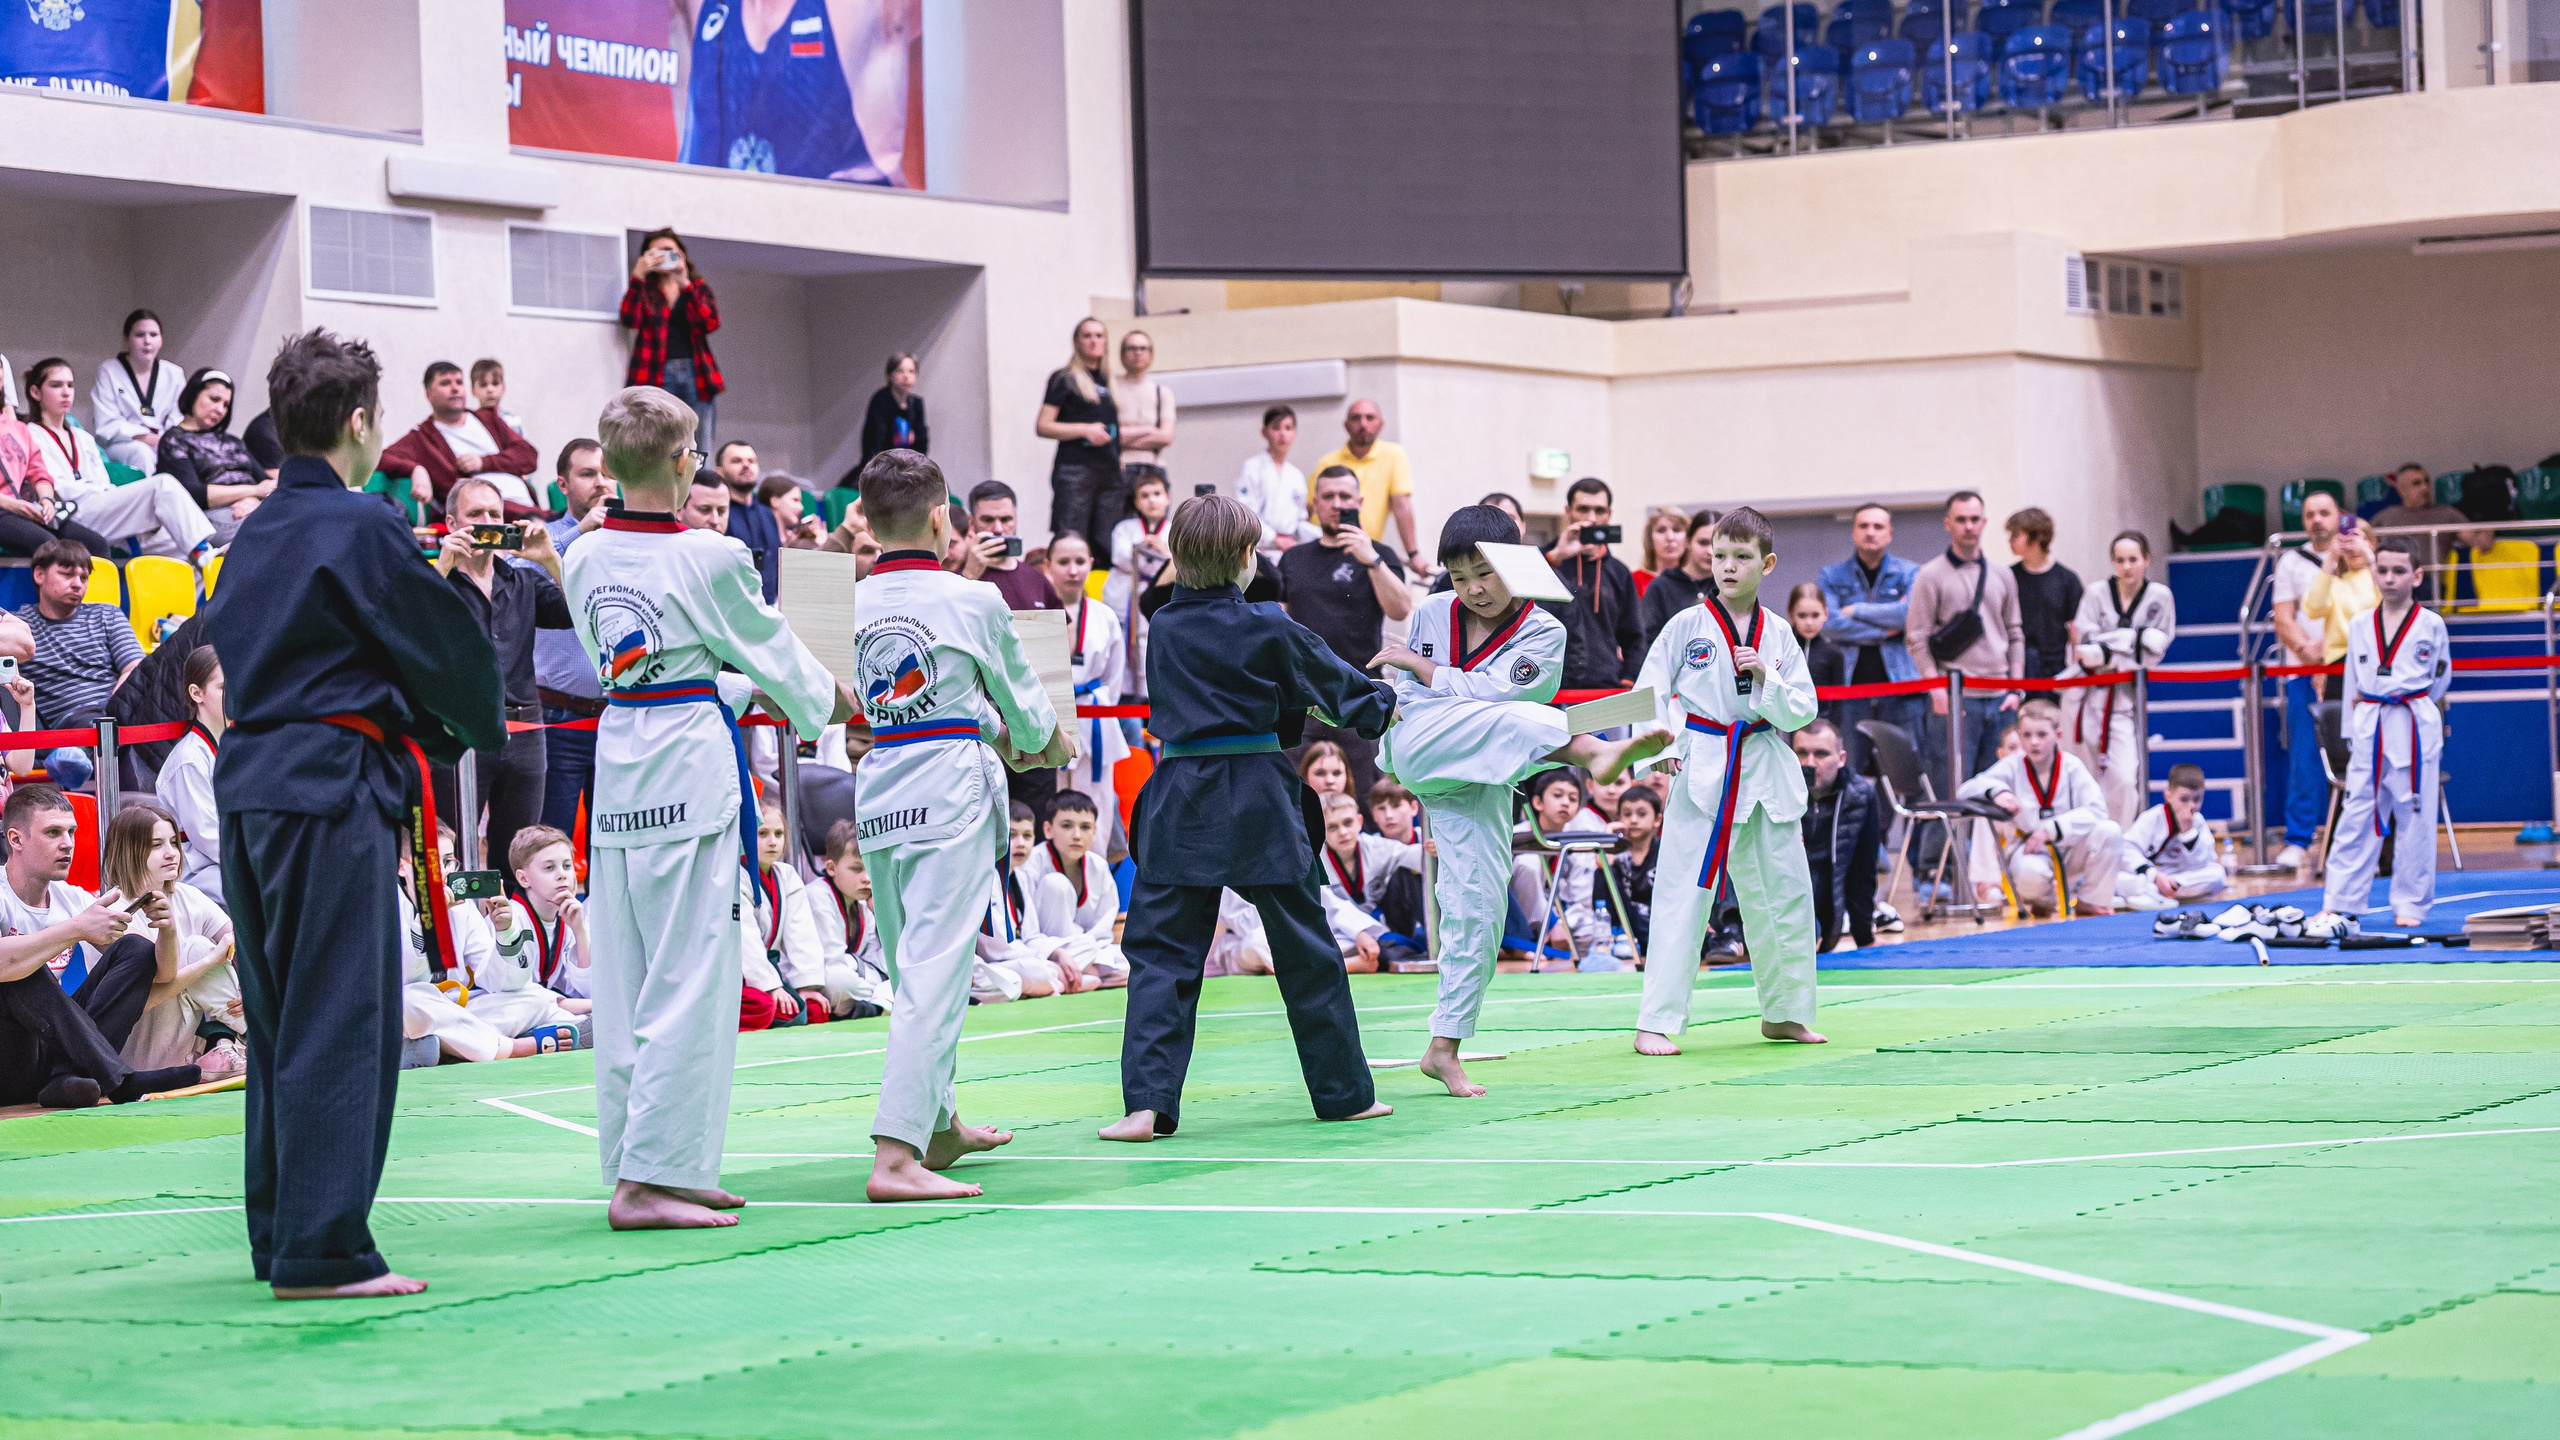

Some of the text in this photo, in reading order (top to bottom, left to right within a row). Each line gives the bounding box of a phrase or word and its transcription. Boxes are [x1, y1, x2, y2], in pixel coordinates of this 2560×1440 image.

[557, 34, 679, 86] ЧЕМПИОН
[854, 615, 937, 646] МЕЖРЕГИОНАЛЬНЫЙ
[914, 634, 928, 648] КЛУБ
[596, 802, 687, 833] МЫТИЩИ
